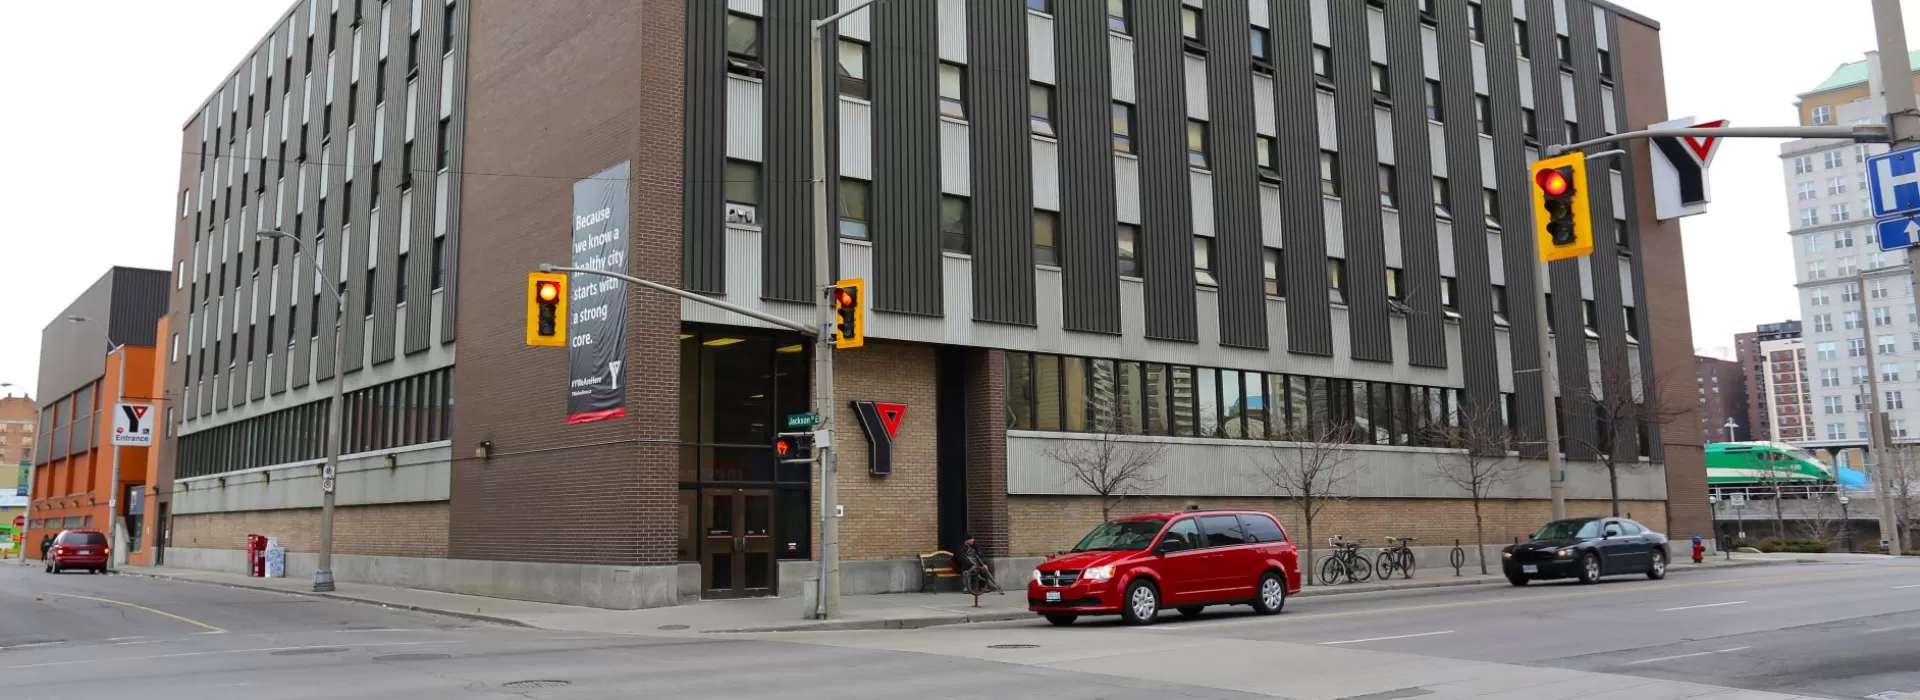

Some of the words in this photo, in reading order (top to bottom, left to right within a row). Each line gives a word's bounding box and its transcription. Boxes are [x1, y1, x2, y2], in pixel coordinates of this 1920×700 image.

[1876, 149, 1920, 212] H
[576, 207, 610, 230] Because
[575, 240, 587, 254] we
[588, 233, 613, 250] know
[613, 228, 620, 241] a
[607, 248, 625, 267] city
[574, 283, 597, 300] starts
[599, 275, 619, 293] with
[573, 312, 579, 324] a
[579, 304, 608, 323] strong
[572, 333, 592, 347] core.
[789, 416, 810, 425] Jackson
